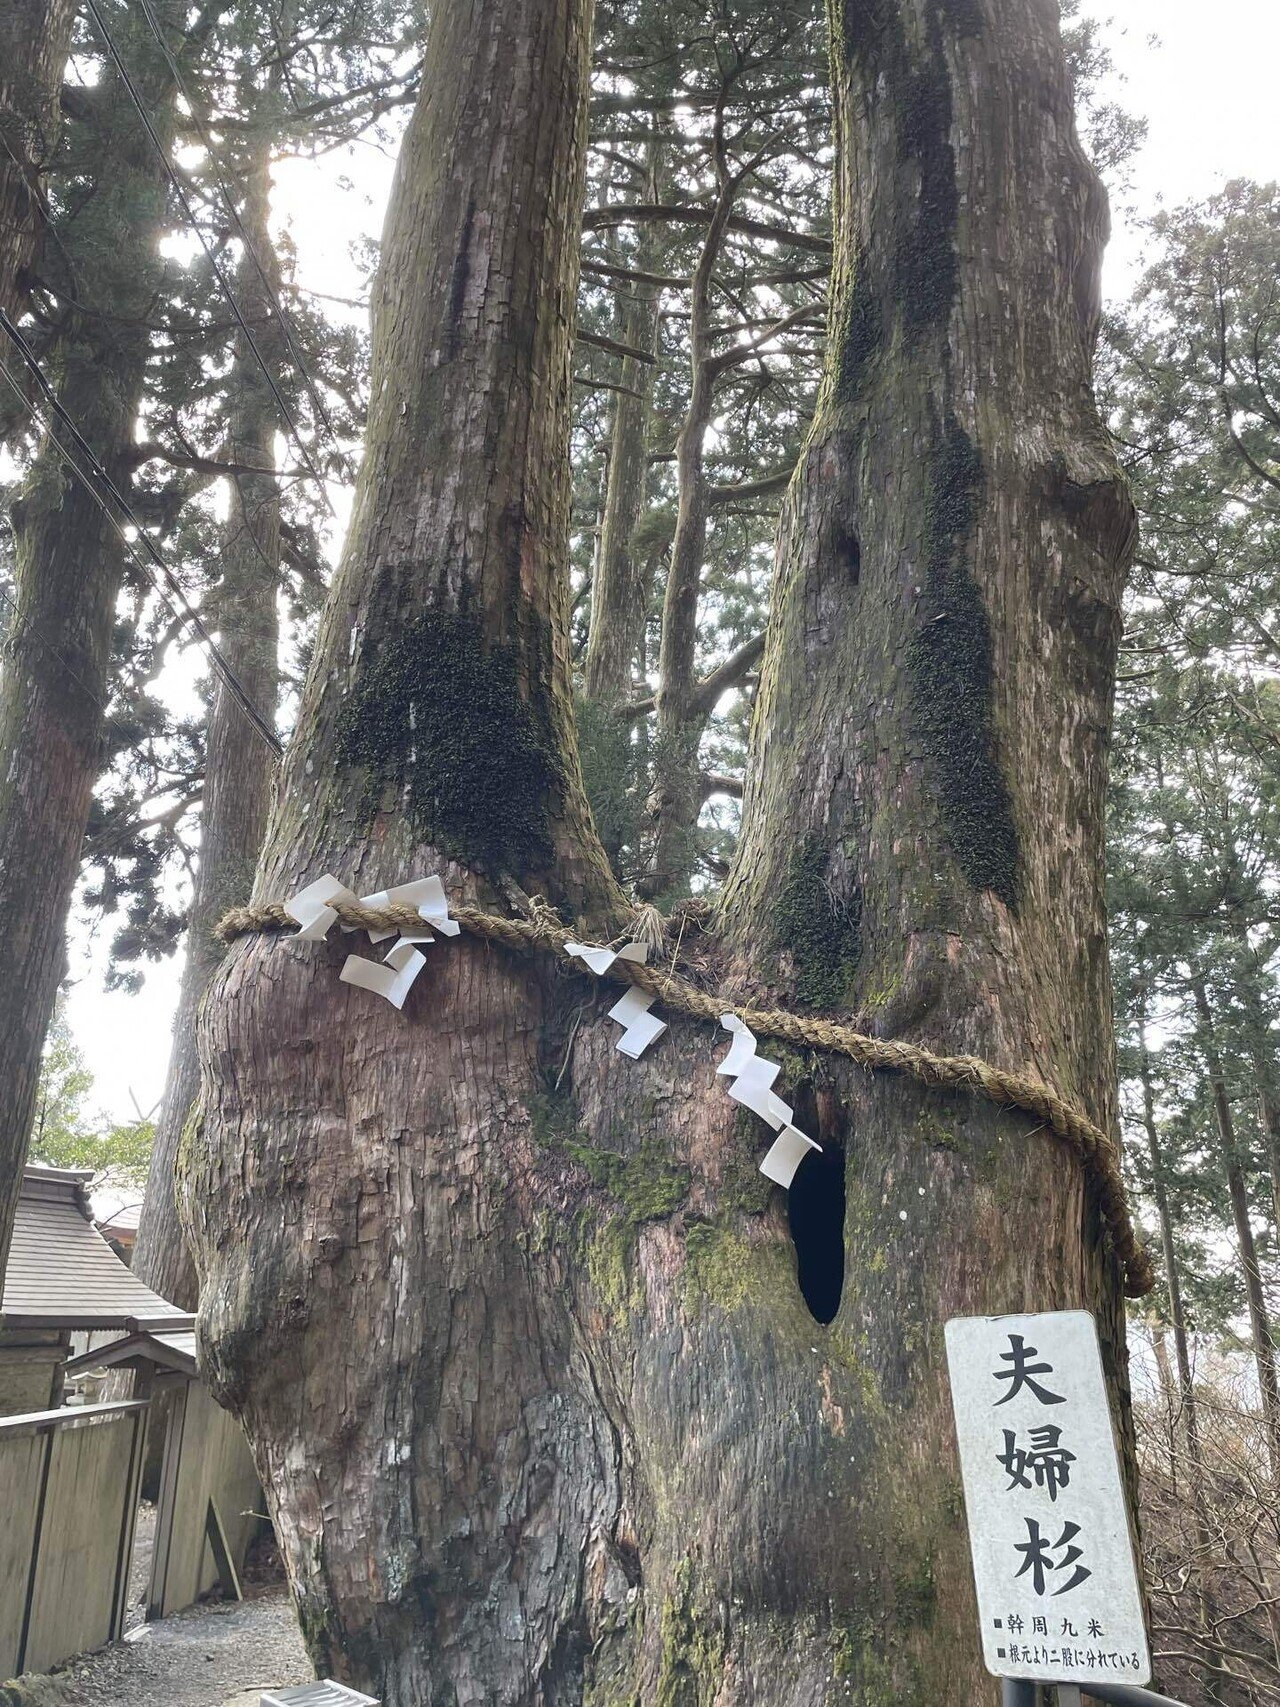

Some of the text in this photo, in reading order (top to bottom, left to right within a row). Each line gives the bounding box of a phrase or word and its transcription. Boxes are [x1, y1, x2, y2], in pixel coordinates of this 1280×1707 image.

[992, 1334, 1092, 1596] 夫婦杉
[1007, 1614, 1105, 1639] 幹周九米
[1009, 1643, 1140, 1670] 根元より二股に分れている
